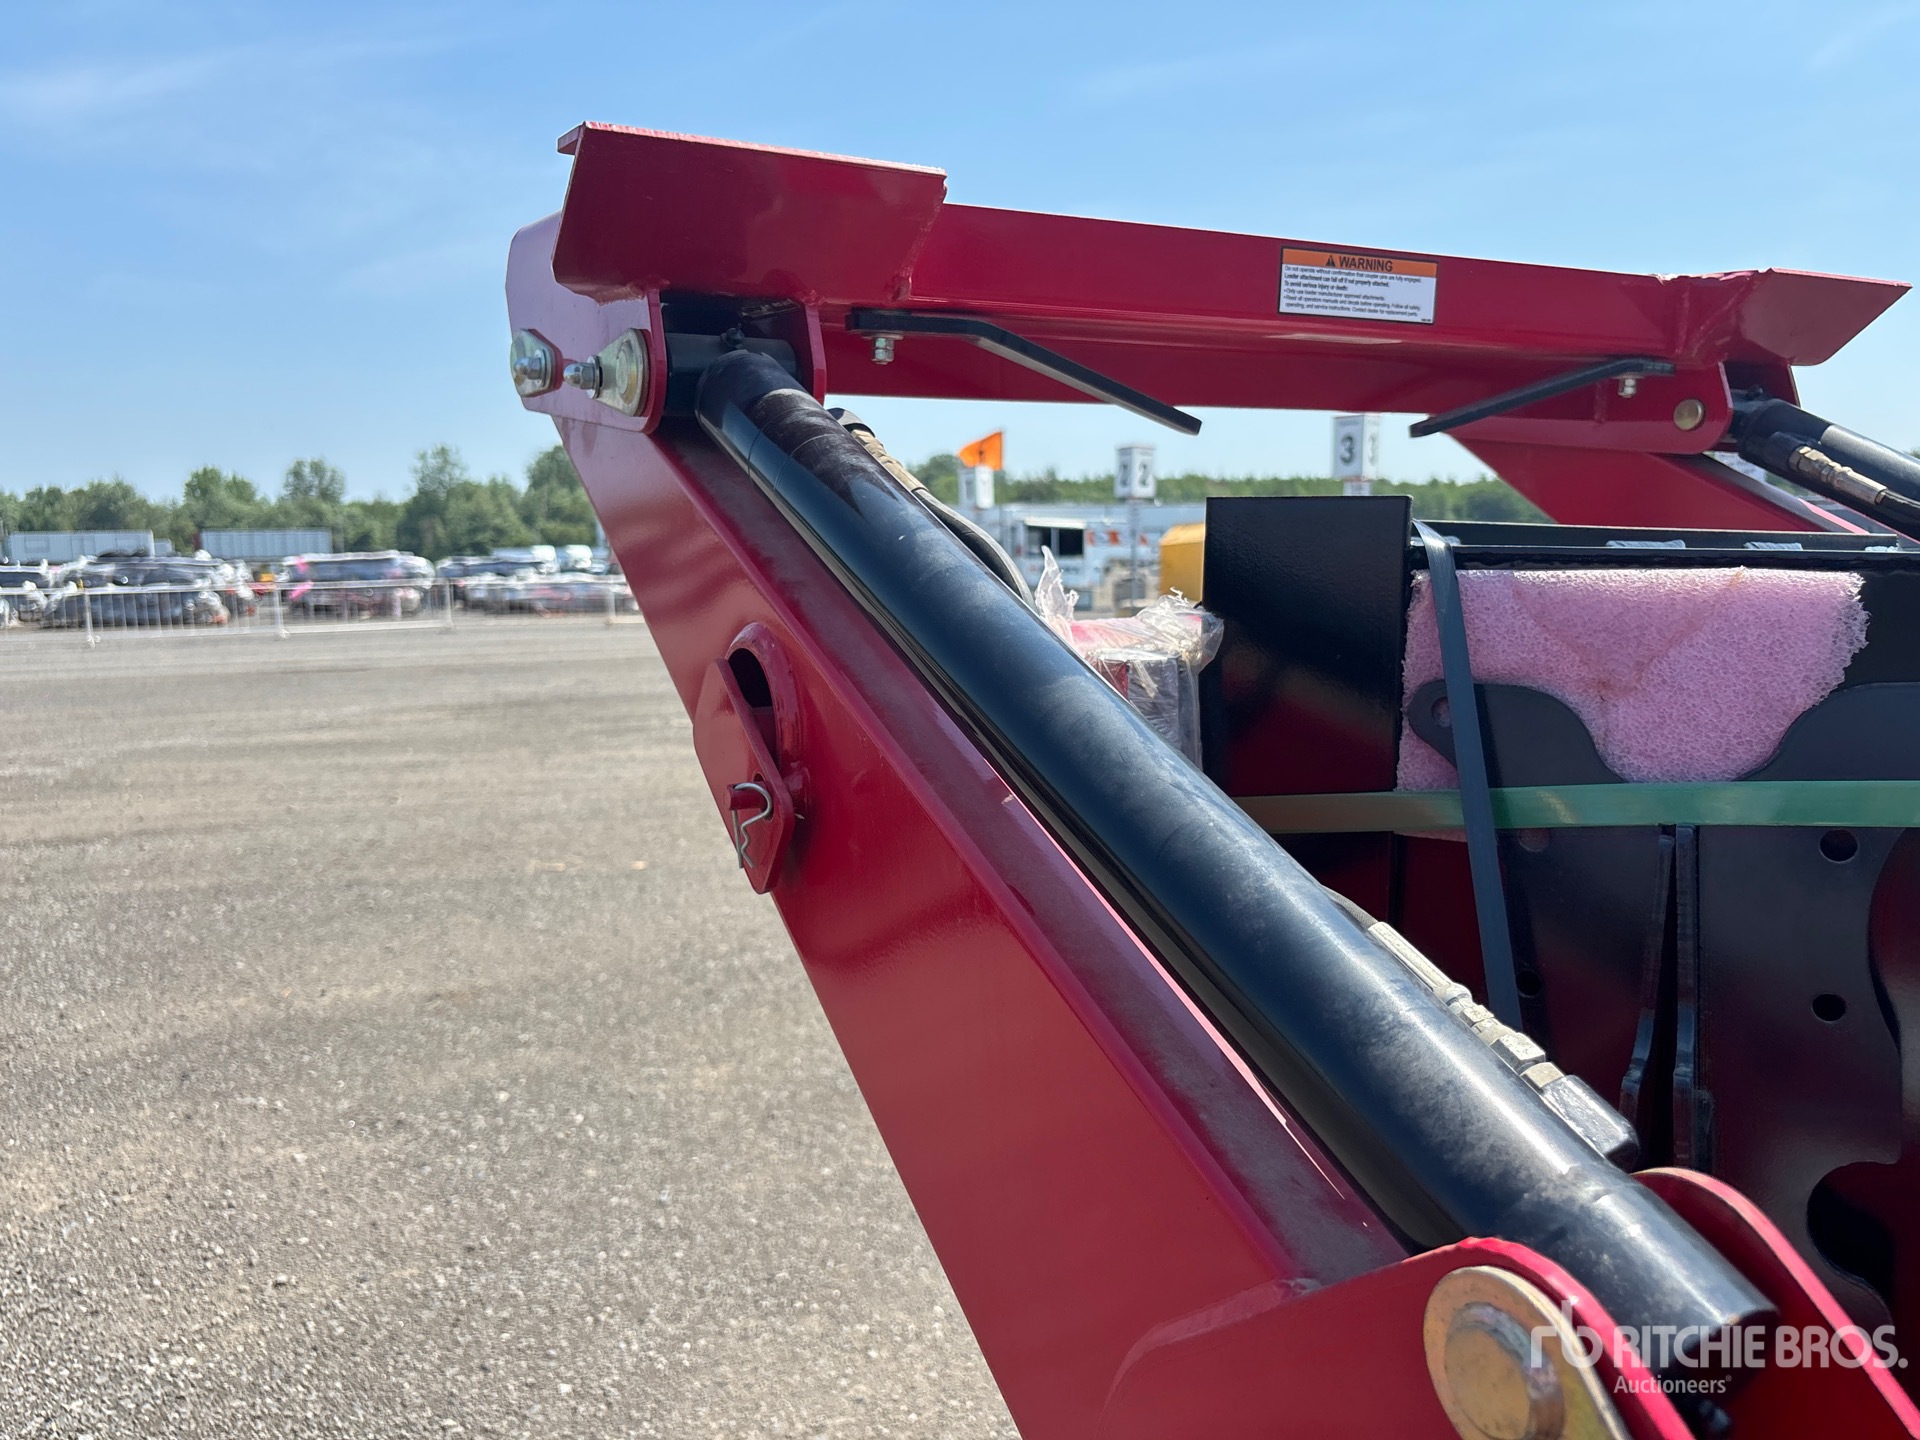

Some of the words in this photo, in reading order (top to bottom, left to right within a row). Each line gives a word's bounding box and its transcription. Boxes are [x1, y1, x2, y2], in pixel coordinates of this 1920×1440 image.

[1339, 256, 1393, 272] WARNING
[1341, 434, 1355, 466] 3
[1138, 462, 1150, 488] 2
